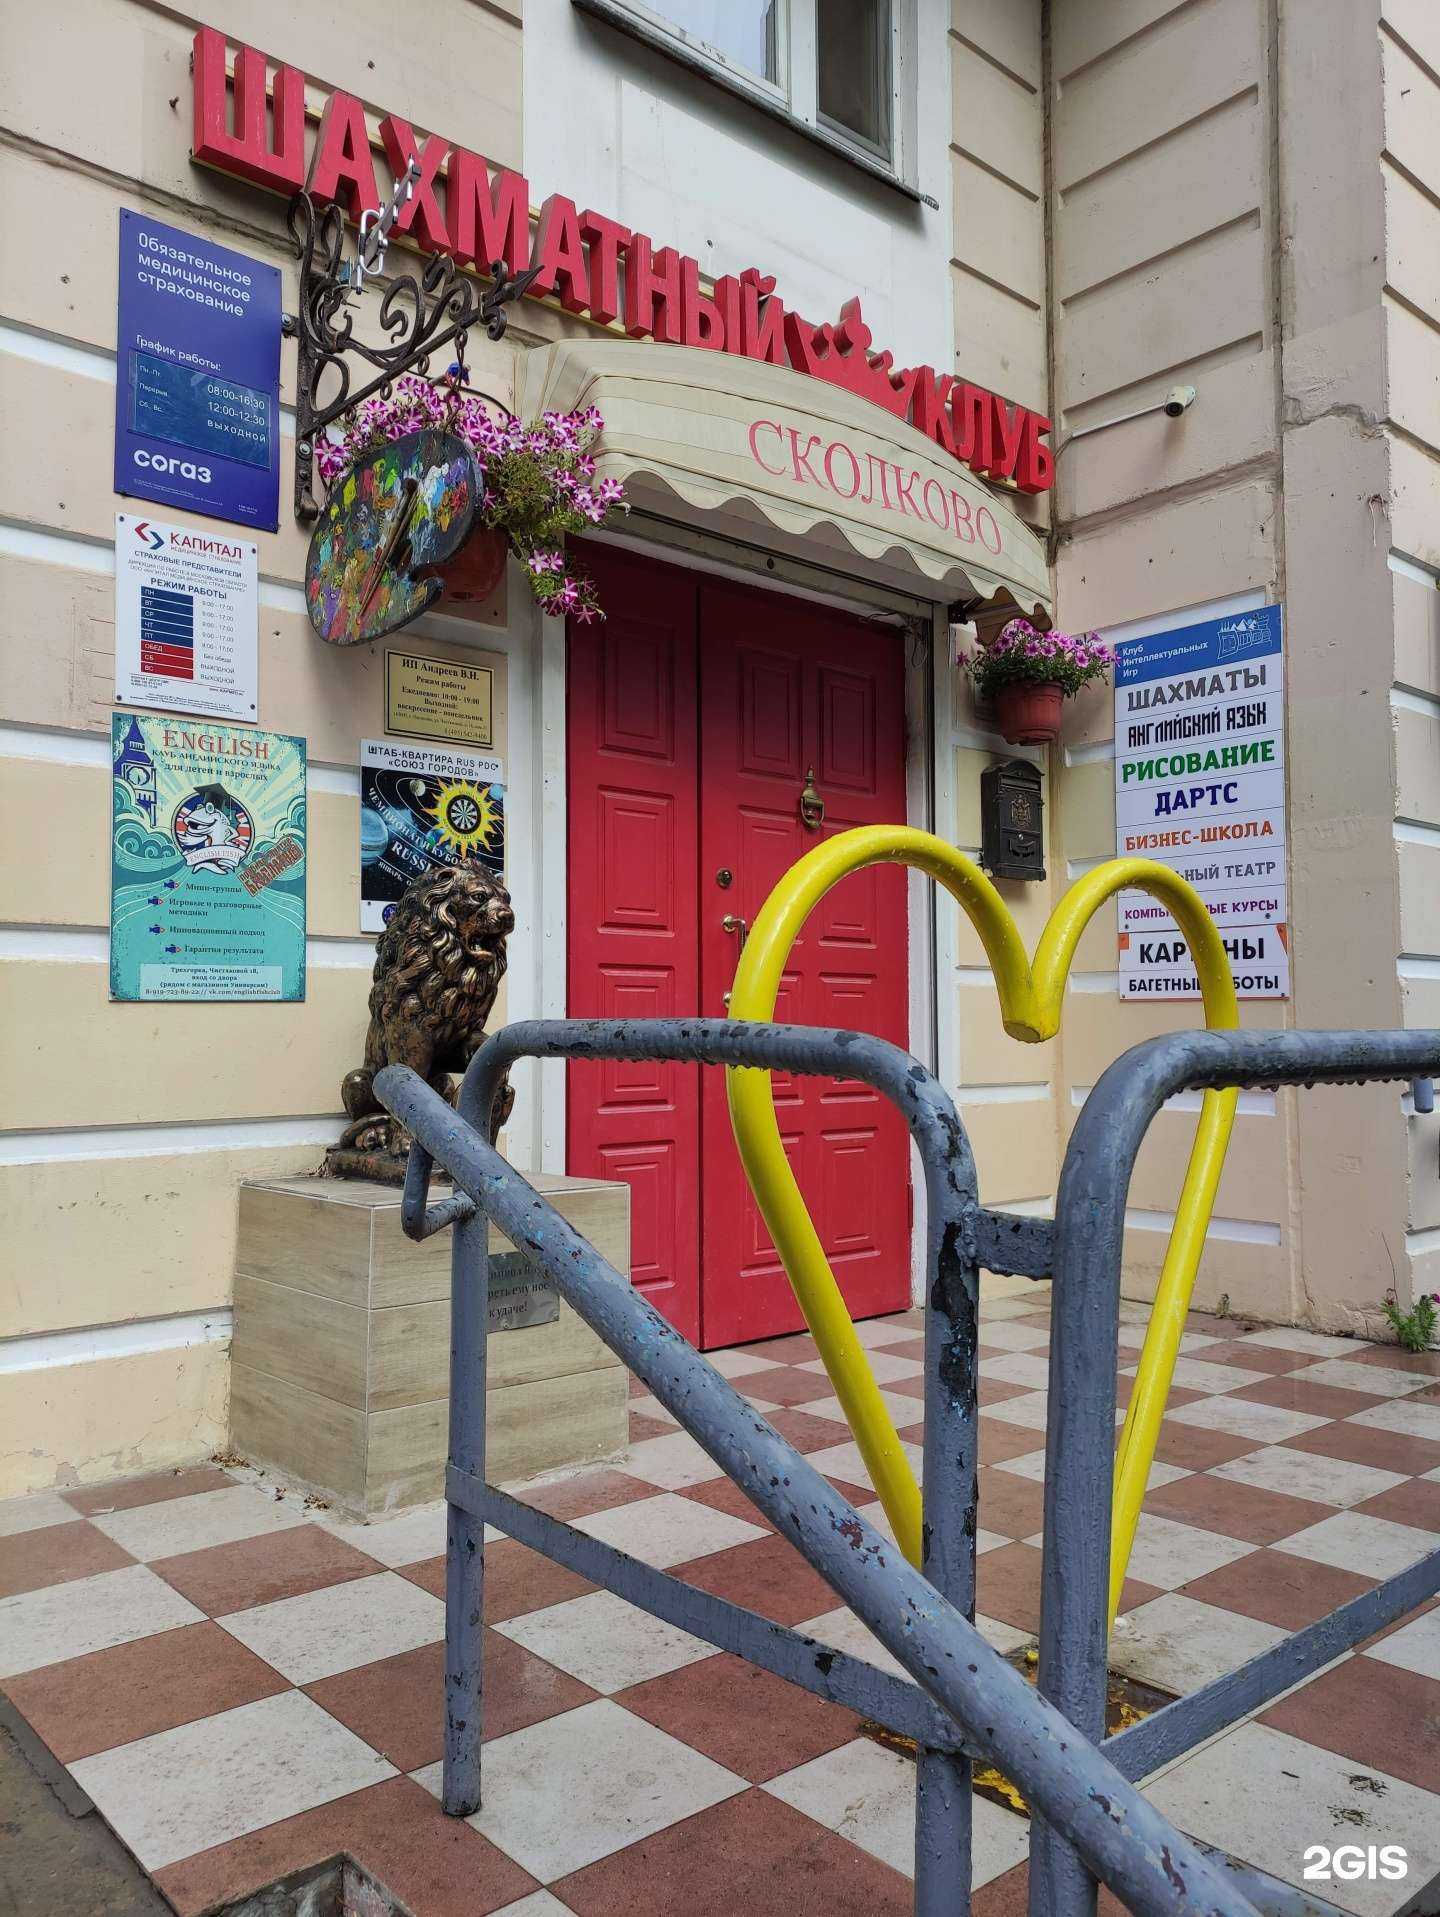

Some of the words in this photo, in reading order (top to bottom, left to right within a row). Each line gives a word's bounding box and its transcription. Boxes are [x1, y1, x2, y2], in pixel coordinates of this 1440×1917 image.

[138, 232, 252, 286] Обязательное
[193, 27, 784, 366] ШАХМАТНЫЙ
[909, 364, 1055, 493] КЛУБ
[138, 253, 251, 302] медицинское
[137, 271, 244, 317] страхование
[136, 334, 176, 356] График
[178, 350, 221, 371] работы:
[207, 384, 265, 410] 08:00-16:30
[207, 401, 265, 426] 12:00-12:30
[207, 418, 267, 443] выходной
[133, 449, 212, 484] согаз
[749, 420, 1003, 556] СКОЛКОВО
[170, 531, 242, 559] КАПИТАЛ
[134, 550, 181, 565] СТРАХОВЫЕ
[181, 560, 242, 578] ПРЕДСТАВИТЕЛИ
[150, 577, 186, 591] РЕЖИМ
[188, 585, 227, 600] РАБОТЫ
[144, 599, 154, 607] ВТ
[144, 610, 154, 618] СР
[1122, 643, 1144, 656] Клуб
[1122, 641, 1209, 667] Интеллектуальных
[401, 658, 418, 670] ИП
[420, 662, 458, 677] Андреев
[460, 669, 480, 681] В.Н.
[1122, 668, 1138, 678] Игр
[402, 686, 440, 698] Ежедневно:
[416, 675, 440, 686] Режим
[441, 681, 466, 691] работы
[1128, 664, 1266, 712] ШАХМАТЫ
[1128, 706, 1221, 748] АНГЛИЙСКИЙ
[1226, 701, 1267, 731] ЯЗЫК
[162, 729, 269, 760] ENGLISH
[250, 761, 281, 771] ЯЗЫКА
[368, 745, 453, 764] ШТАБ-КВАРТИРА
[456, 757, 474, 767] RUS
[478, 761, 497, 771] PDC
[388, 758, 425, 770] «СОЮЗ
[428, 763, 479, 777] ГОРОДОВ»
[1122, 739, 1275, 783] РИСОВАНИЕ
[164, 764, 186, 774] для
[187, 765, 214, 775] детей
[225, 770, 268, 781] взрослых
[1154, 782, 1238, 816] ДАРТС
[369, 787, 422, 847] ЧЕМПИОНАТ
[1125, 820, 1274, 851] БИЗНЕС-ШКОЛА
[391, 840, 432, 873] RUSSI
[1224, 861, 1276, 880] ТЕАТР
[185, 882, 242, 894] Мини-группы
[168, 898, 206, 908] Игровые
[1232, 899, 1278, 913] КУРСЫ
[239, 929, 266, 937] подход
[184, 945, 221, 955] Гарантия
[223, 947, 264, 955] результата
[1139, 937, 1265, 964] КАРНЫ
[1129, 977, 1201, 992] БАГЕТНЫ
